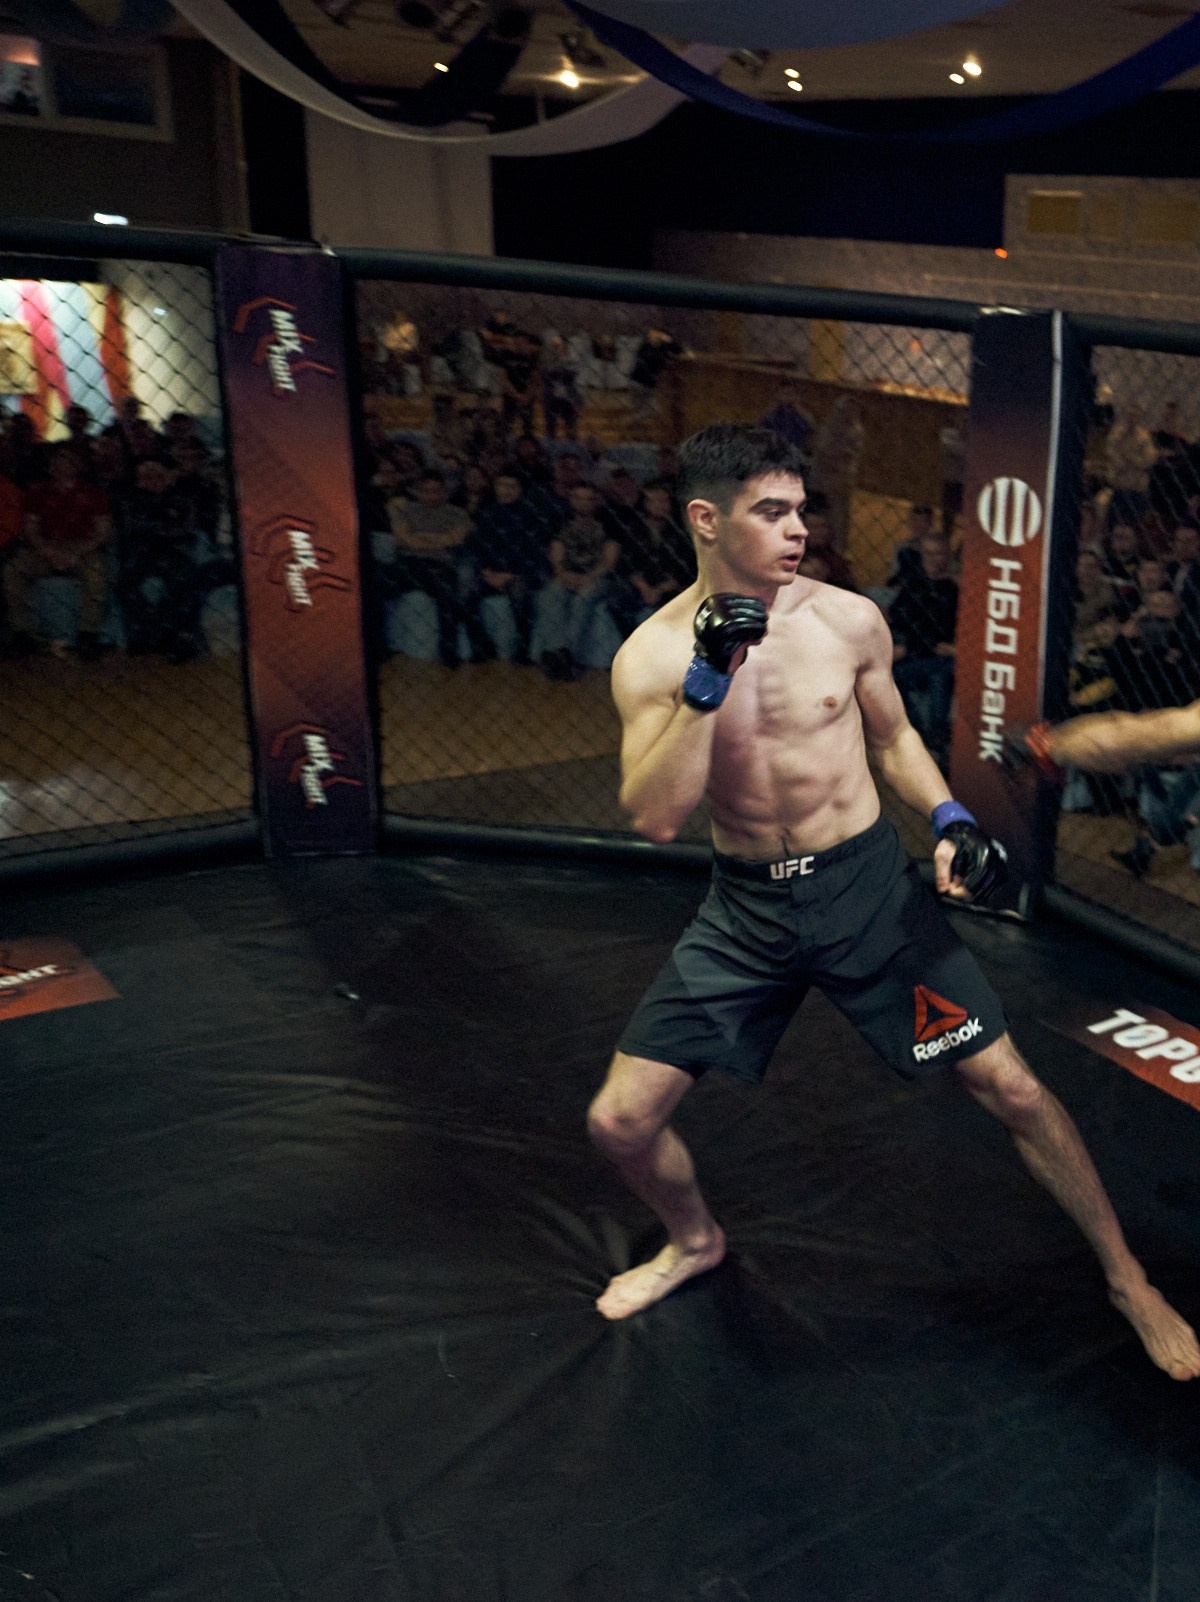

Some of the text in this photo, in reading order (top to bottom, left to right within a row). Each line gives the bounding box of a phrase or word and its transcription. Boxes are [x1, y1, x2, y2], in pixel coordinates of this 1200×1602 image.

[268, 309, 304, 354] MIX
[286, 530, 319, 571] MIX
[978, 557, 1023, 765] НБД Банк
[302, 734, 335, 771] MIX
[769, 855, 815, 880] UFC
[912, 1017, 984, 1063] Reebok
